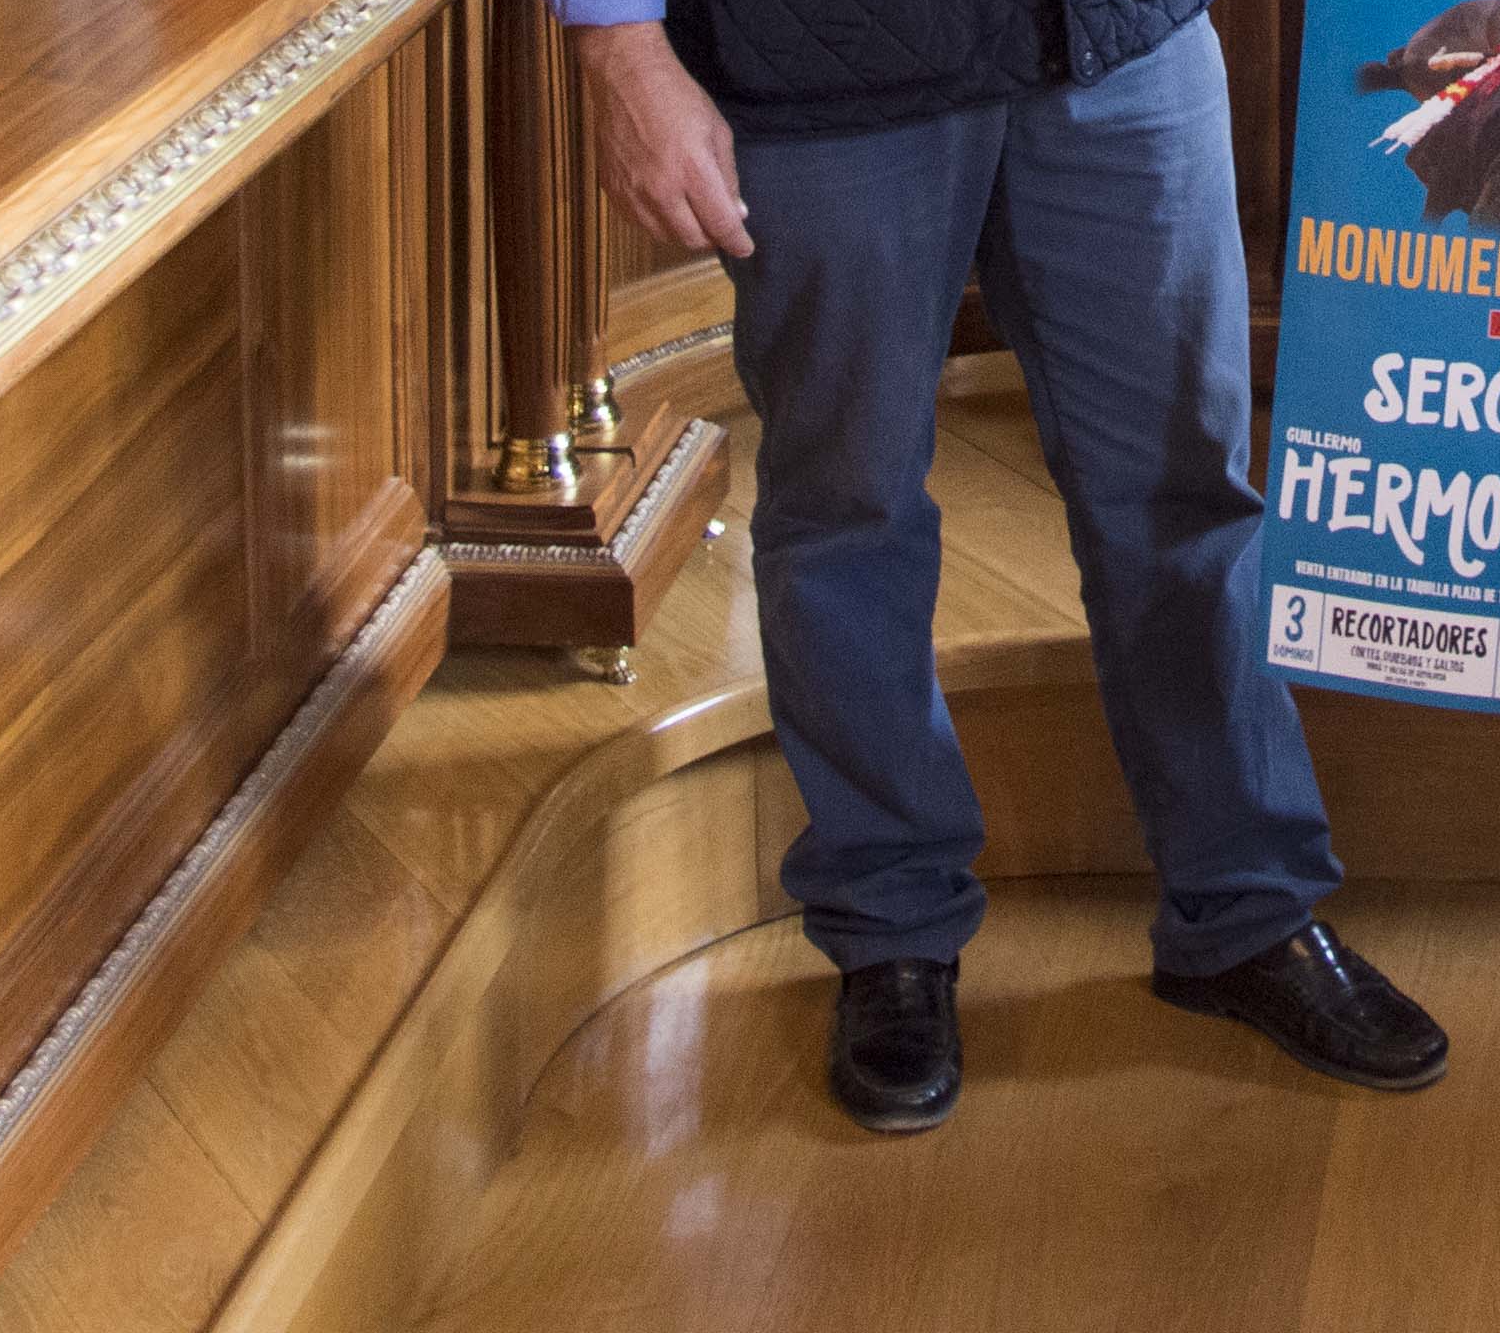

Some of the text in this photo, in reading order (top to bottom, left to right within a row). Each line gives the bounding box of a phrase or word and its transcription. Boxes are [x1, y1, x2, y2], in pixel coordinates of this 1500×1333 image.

[1286, 427, 1361, 453] GUILLERMO
[1285, 595, 1306, 642] 3
[1332, 606, 1487, 658] RECORTADORES
